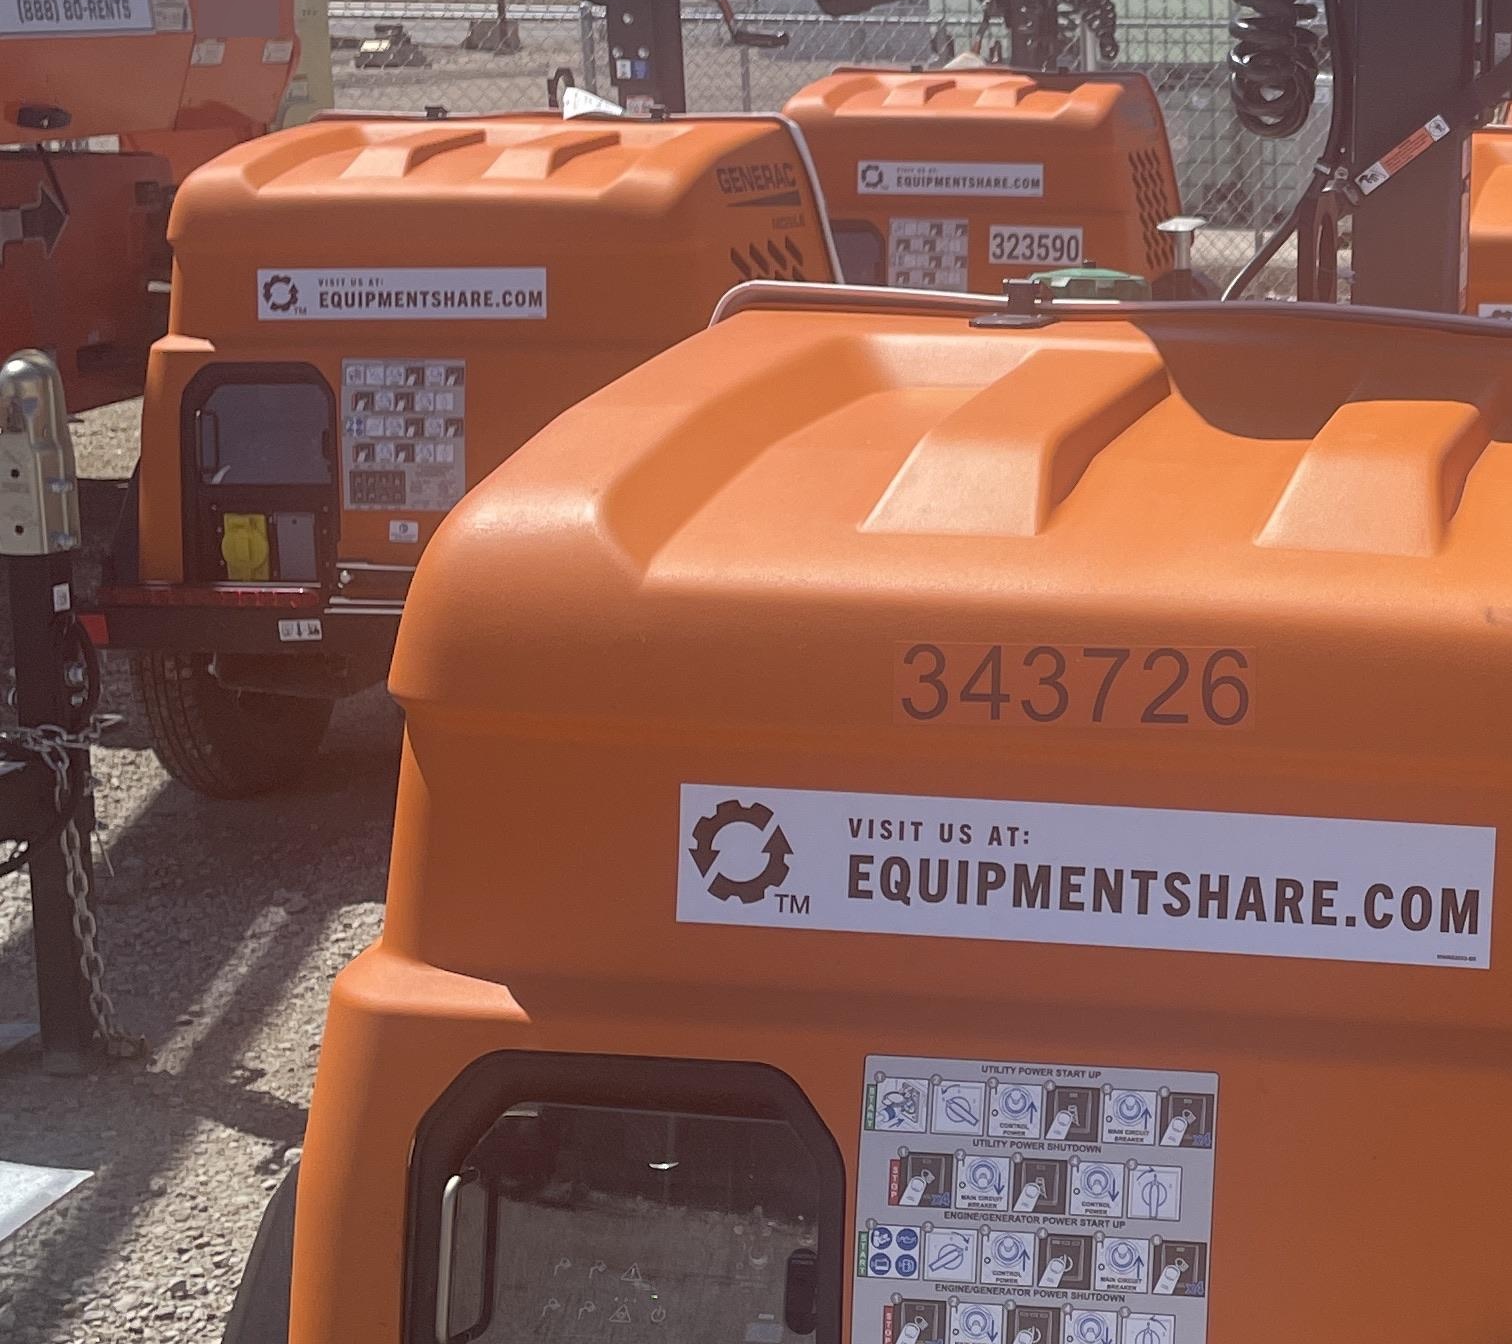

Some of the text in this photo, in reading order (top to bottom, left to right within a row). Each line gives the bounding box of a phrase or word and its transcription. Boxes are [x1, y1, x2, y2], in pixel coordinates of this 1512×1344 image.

[716, 163, 797, 194] GENERAC
[896, 176, 1041, 190] EQUIPMENTSHARE.COM
[991, 232, 1080, 262] 323590
[318, 277, 347, 287] VISIT
[350, 278, 364, 287] US
[319, 290, 543, 309] EQUIPMENTSHARE.COM
[900, 643, 1250, 726] 343726
[847, 817, 1031, 848] VISIT US AT:
[846, 854, 1480, 935] EQUIPMENTSHARE.COM
[773, 894, 811, 915] TM
[981, 1065, 1102, 1079] UTILITY POWER START UP
[973, 1139, 1102, 1153] UTILITY POWER SHUTDOWN
[944, 1211, 1126, 1229] ENGINE/GENERATOR POWER START UP
[935, 1284, 1126, 1303] ENGINE/GENERATOR POWER SHUTDOWN
